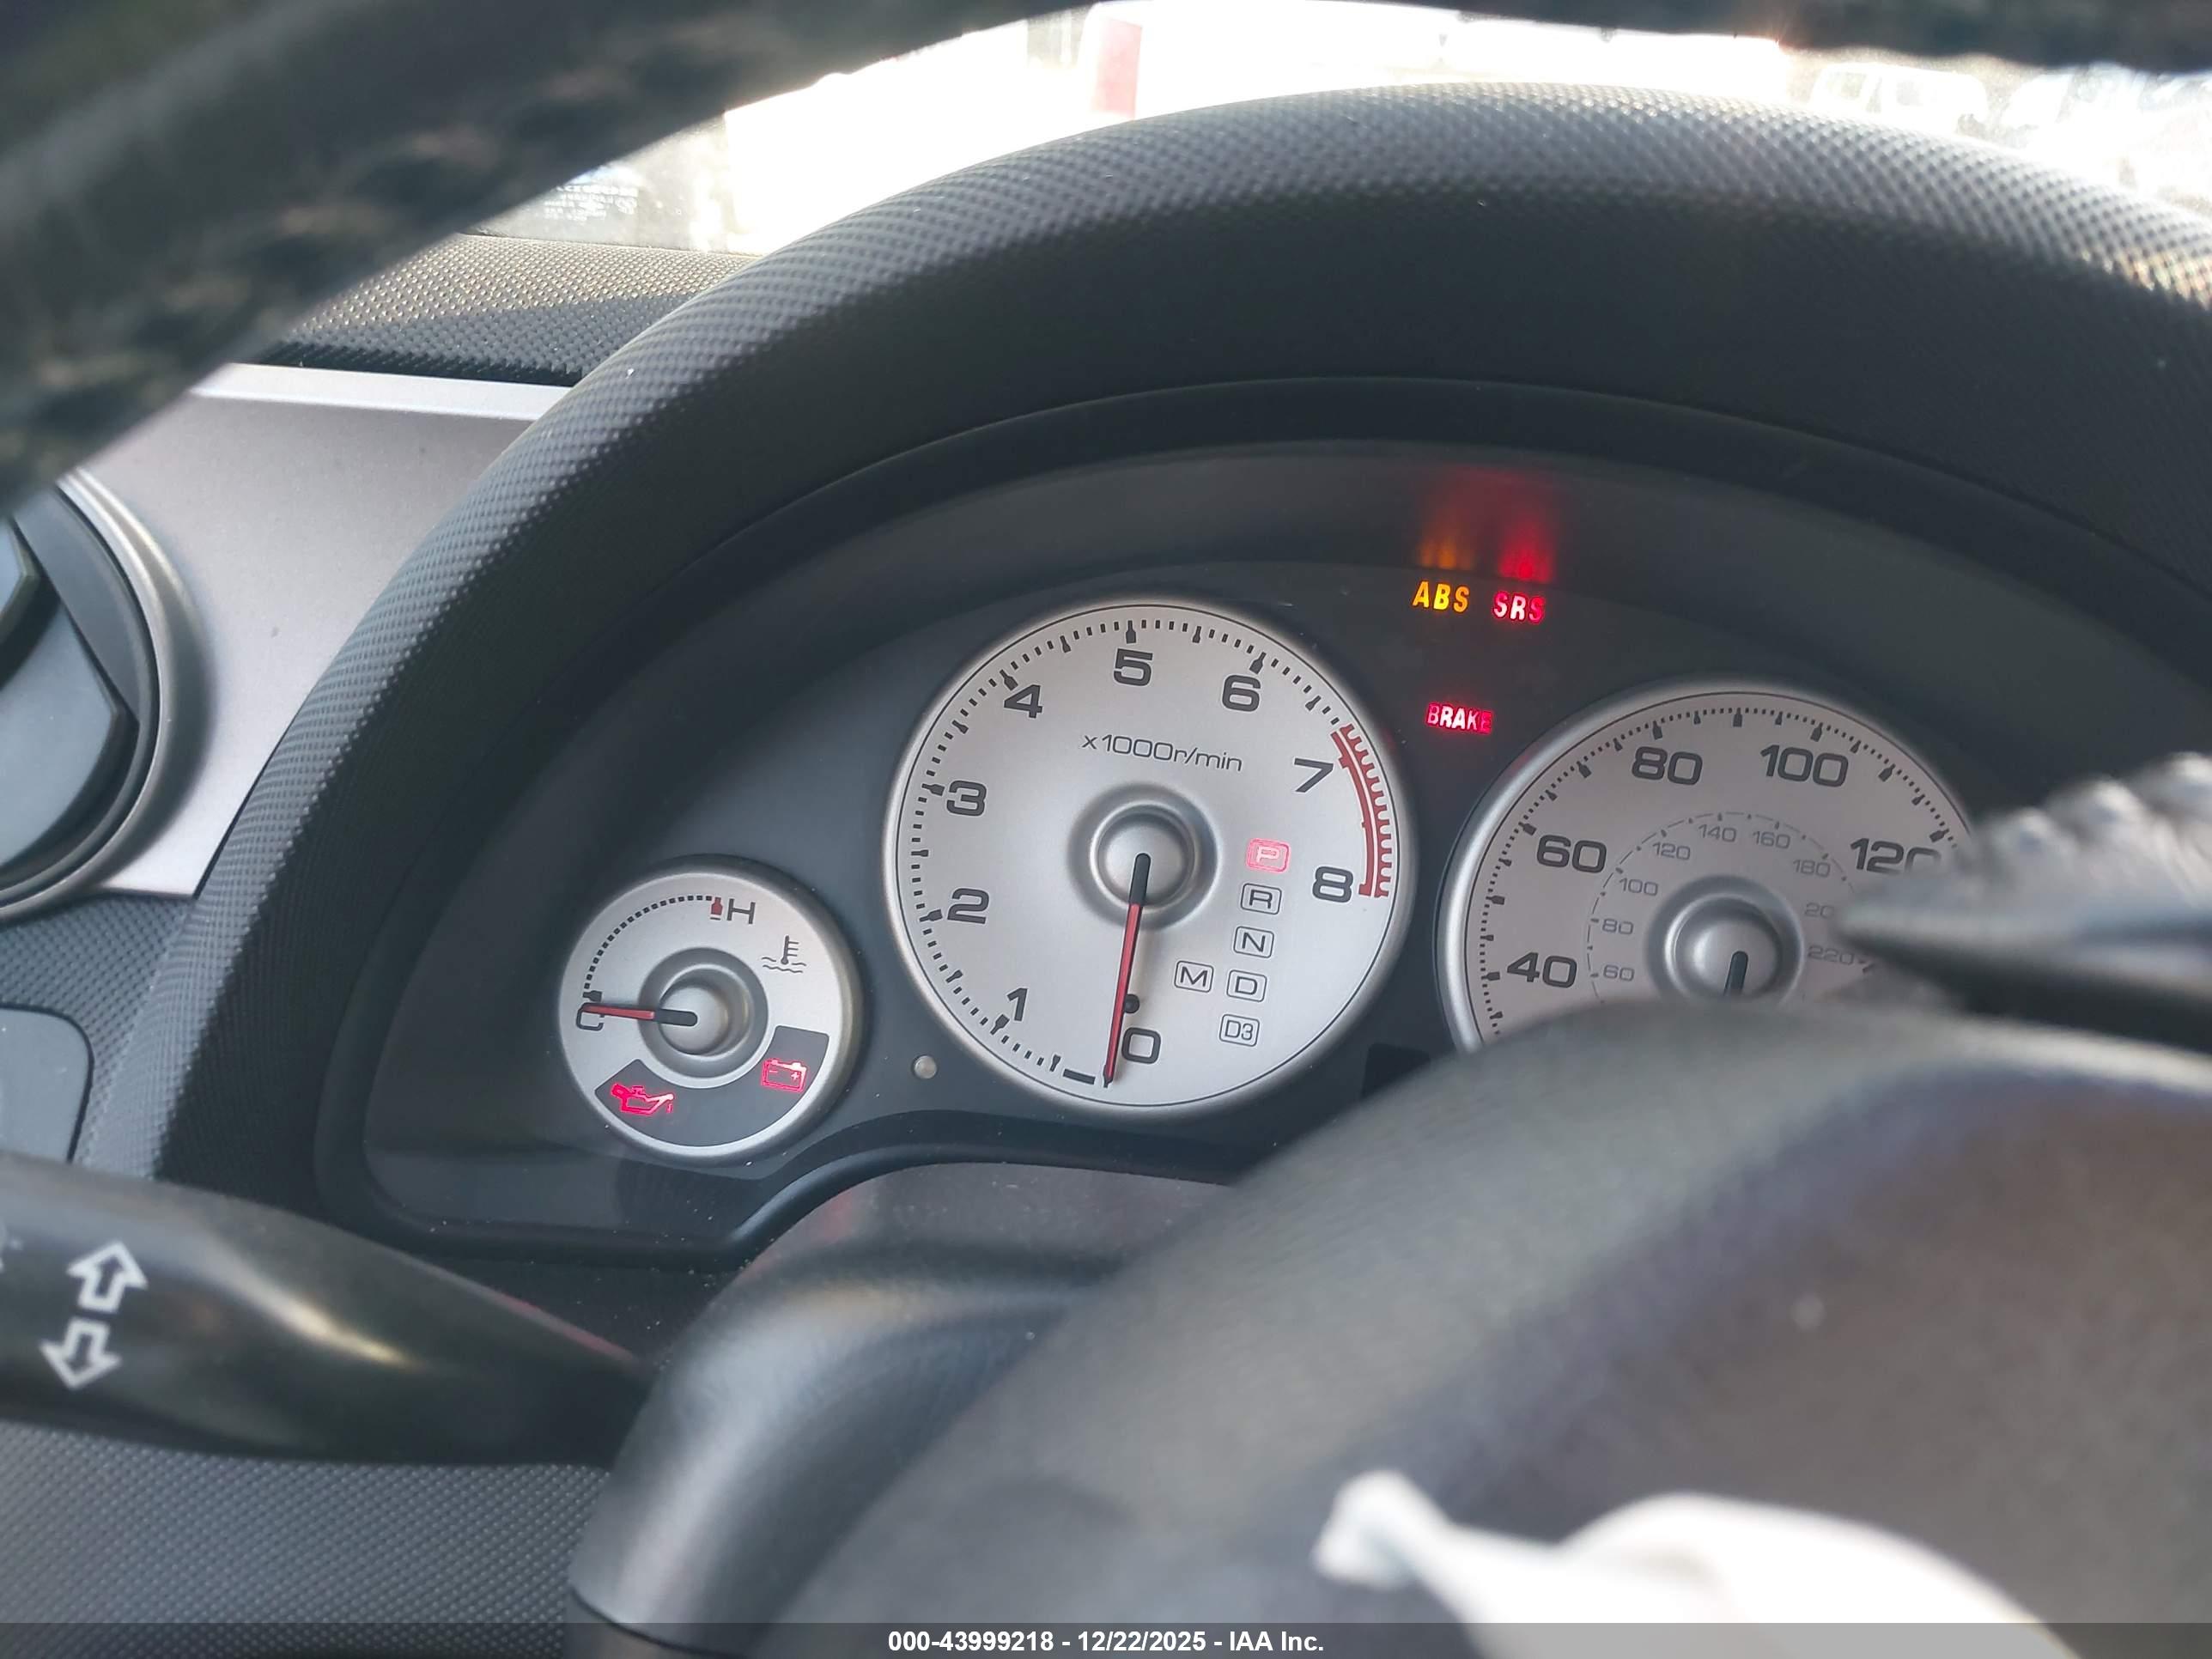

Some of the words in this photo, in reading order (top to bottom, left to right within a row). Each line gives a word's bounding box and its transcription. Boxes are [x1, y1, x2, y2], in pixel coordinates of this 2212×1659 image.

[1412, 580, 1470, 613] ABS
[1493, 591, 1546, 623] SRS
[1114, 648, 1153, 686] 5
[1004, 684, 1042, 718] 4
[1222, 674, 1261, 712] 6
[1426, 702, 1493, 734] BRAKE
[1294, 757, 1334, 793] 7
[1631, 745, 1703, 787] 80
[1760, 744, 1849, 788] 100
[946, 781, 987, 817] 3
[1698, 823, 1737, 843] 140
[1753, 831, 1790, 849] 160
[1256, 846, 1279, 864] P
[1535, 834, 1607, 874] 60
[1652, 842, 1691, 860] 120
[1792, 859, 1832, 878] 180
[1249, 889, 1273, 909] R
[1311, 866, 1353, 903] 8
[1619, 878, 1658, 896] 100
[726, 897, 757, 925] H
[946, 888, 989, 924] 2
[1601, 919, 1634, 935] 80
[1242, 932, 1267, 953] N
[1808, 945, 1855, 965] 220
[1180, 966, 1208, 988] M
[1506, 951, 1577, 988] 40
[1603, 964, 1635, 981] 60
[1235, 975, 1258, 995] D
[576, 1002, 605, 1031] C
[1006, 987, 1030, 1022] 1
[1224, 1019, 1254, 1041] D3
[1121, 1027, 1161, 1064] 0
